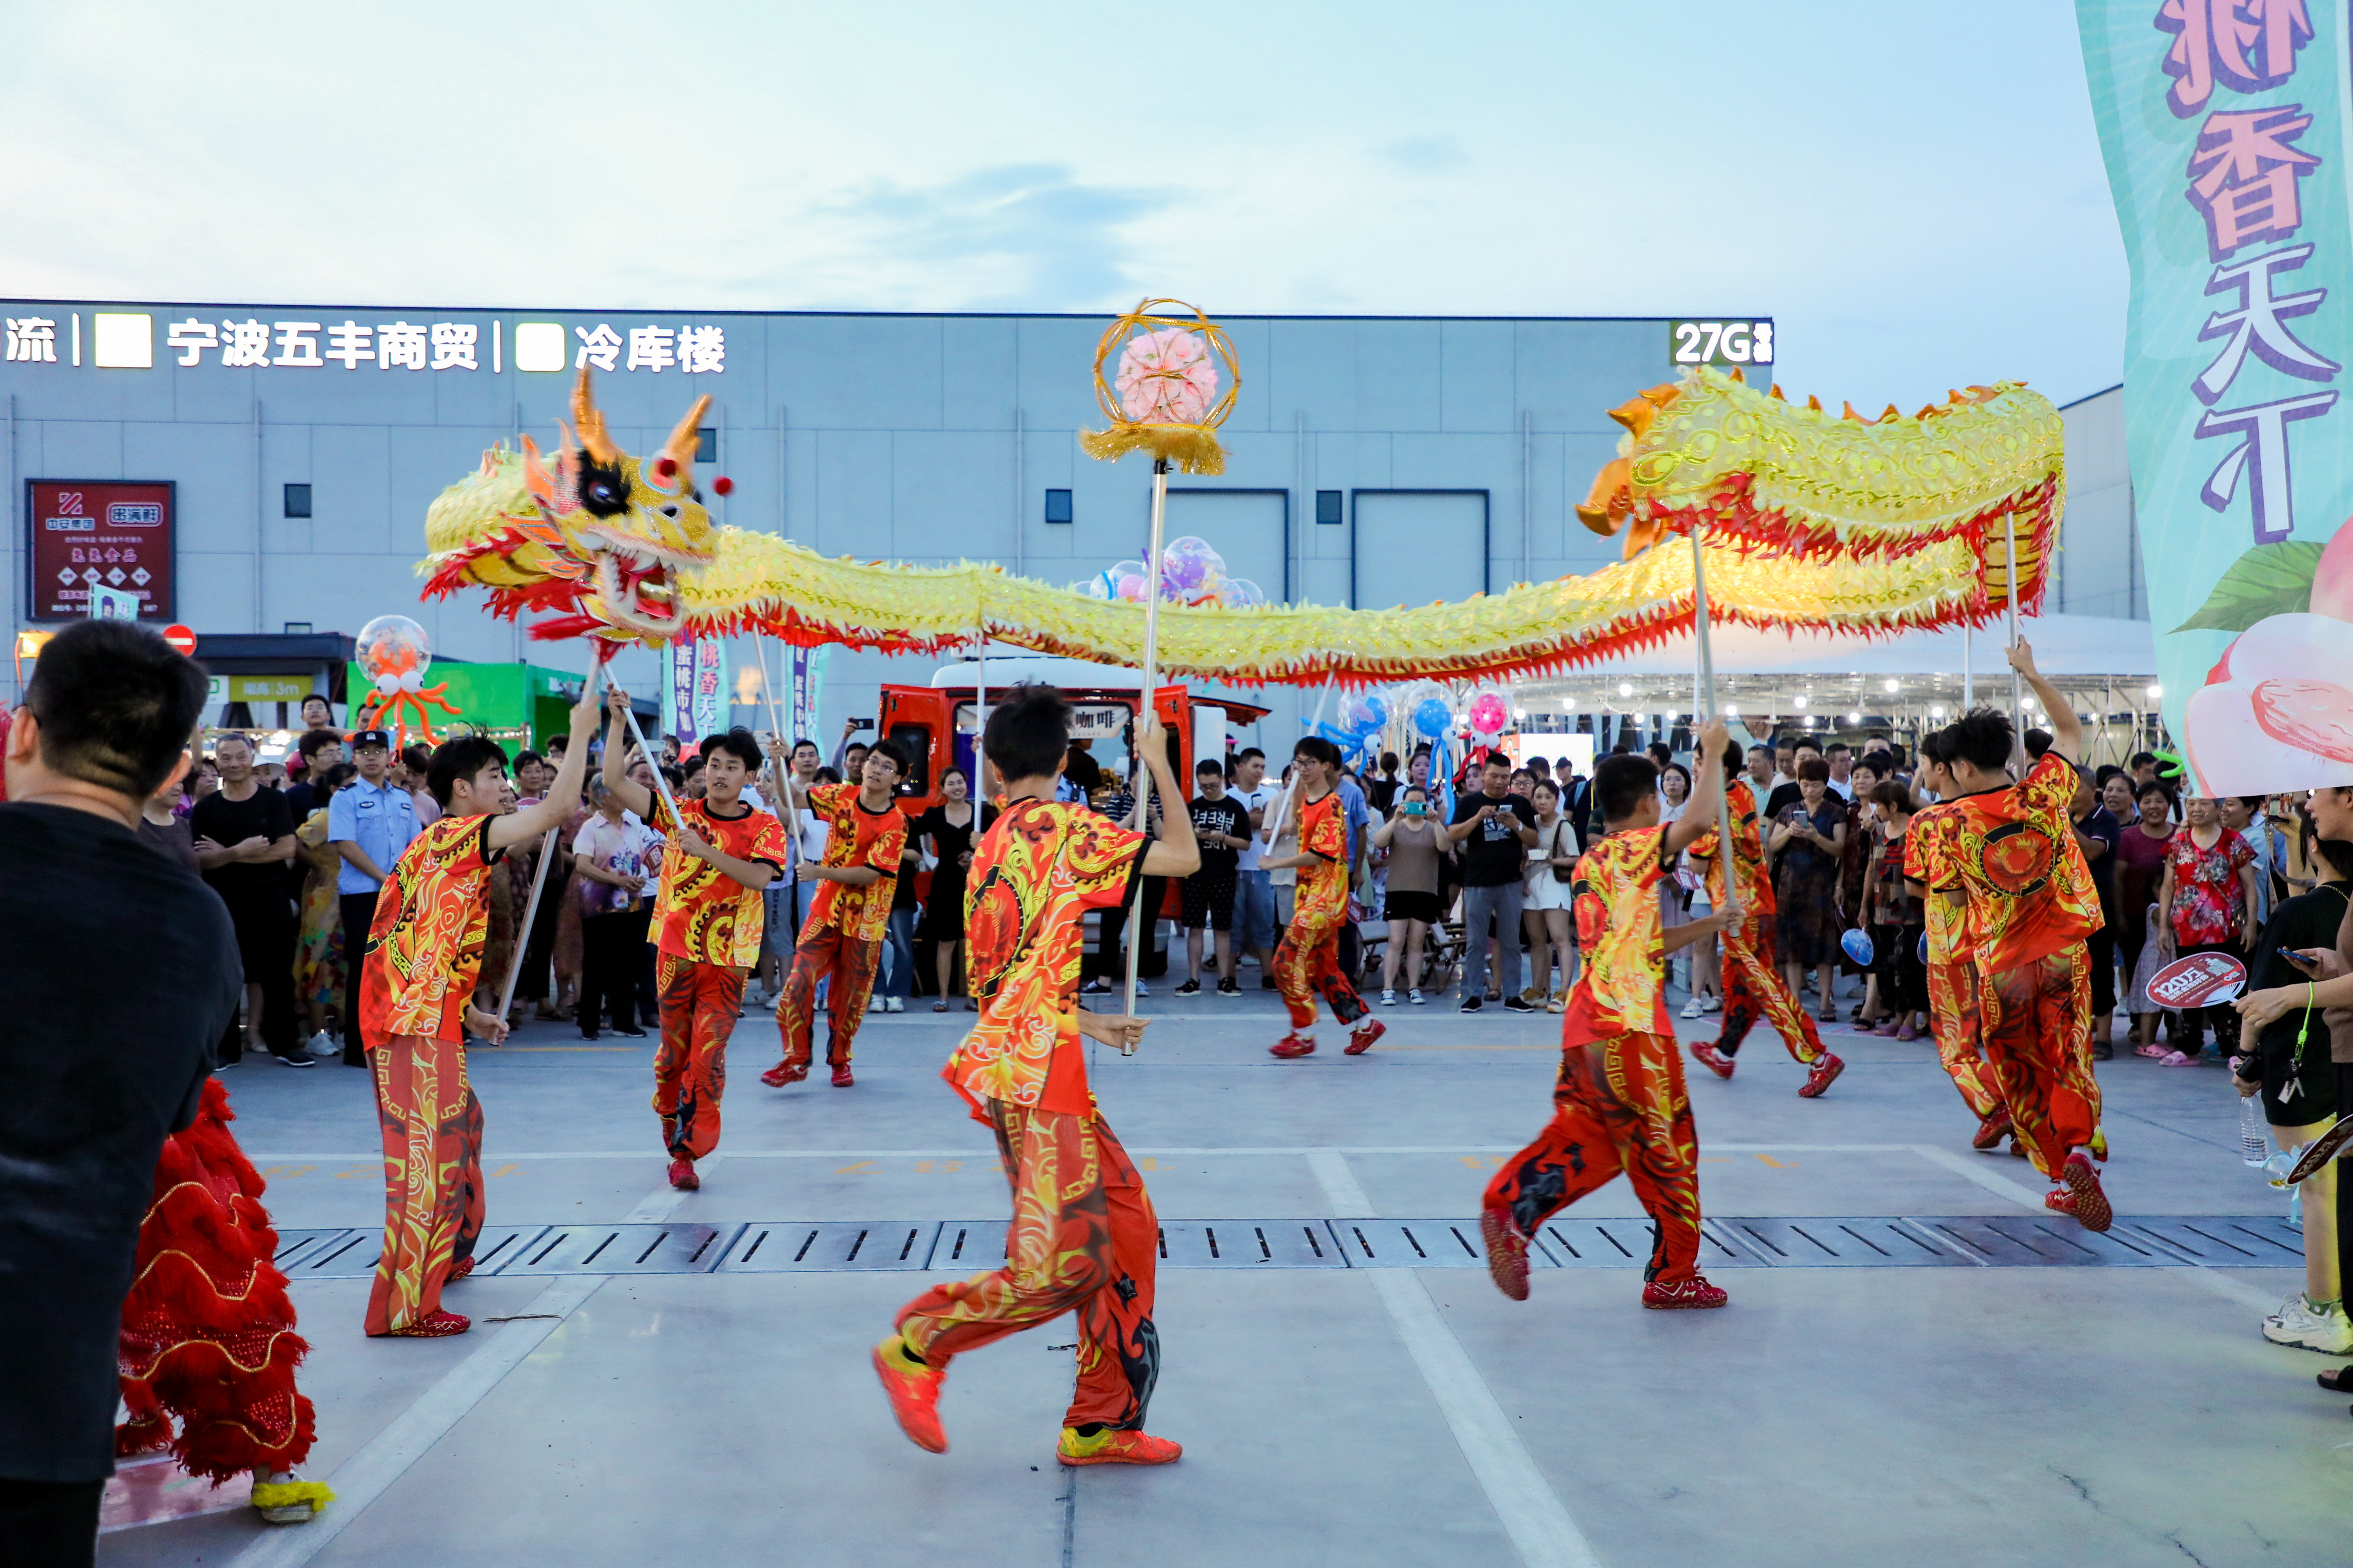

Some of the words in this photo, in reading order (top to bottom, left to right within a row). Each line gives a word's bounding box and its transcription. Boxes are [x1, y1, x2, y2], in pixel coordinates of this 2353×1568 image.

[6, 317, 57, 362] 流
[167, 317, 479, 371] 宁波五丰商贸
[575, 324, 725, 373] 冷库楼
[1675, 323, 1751, 362] 27G
